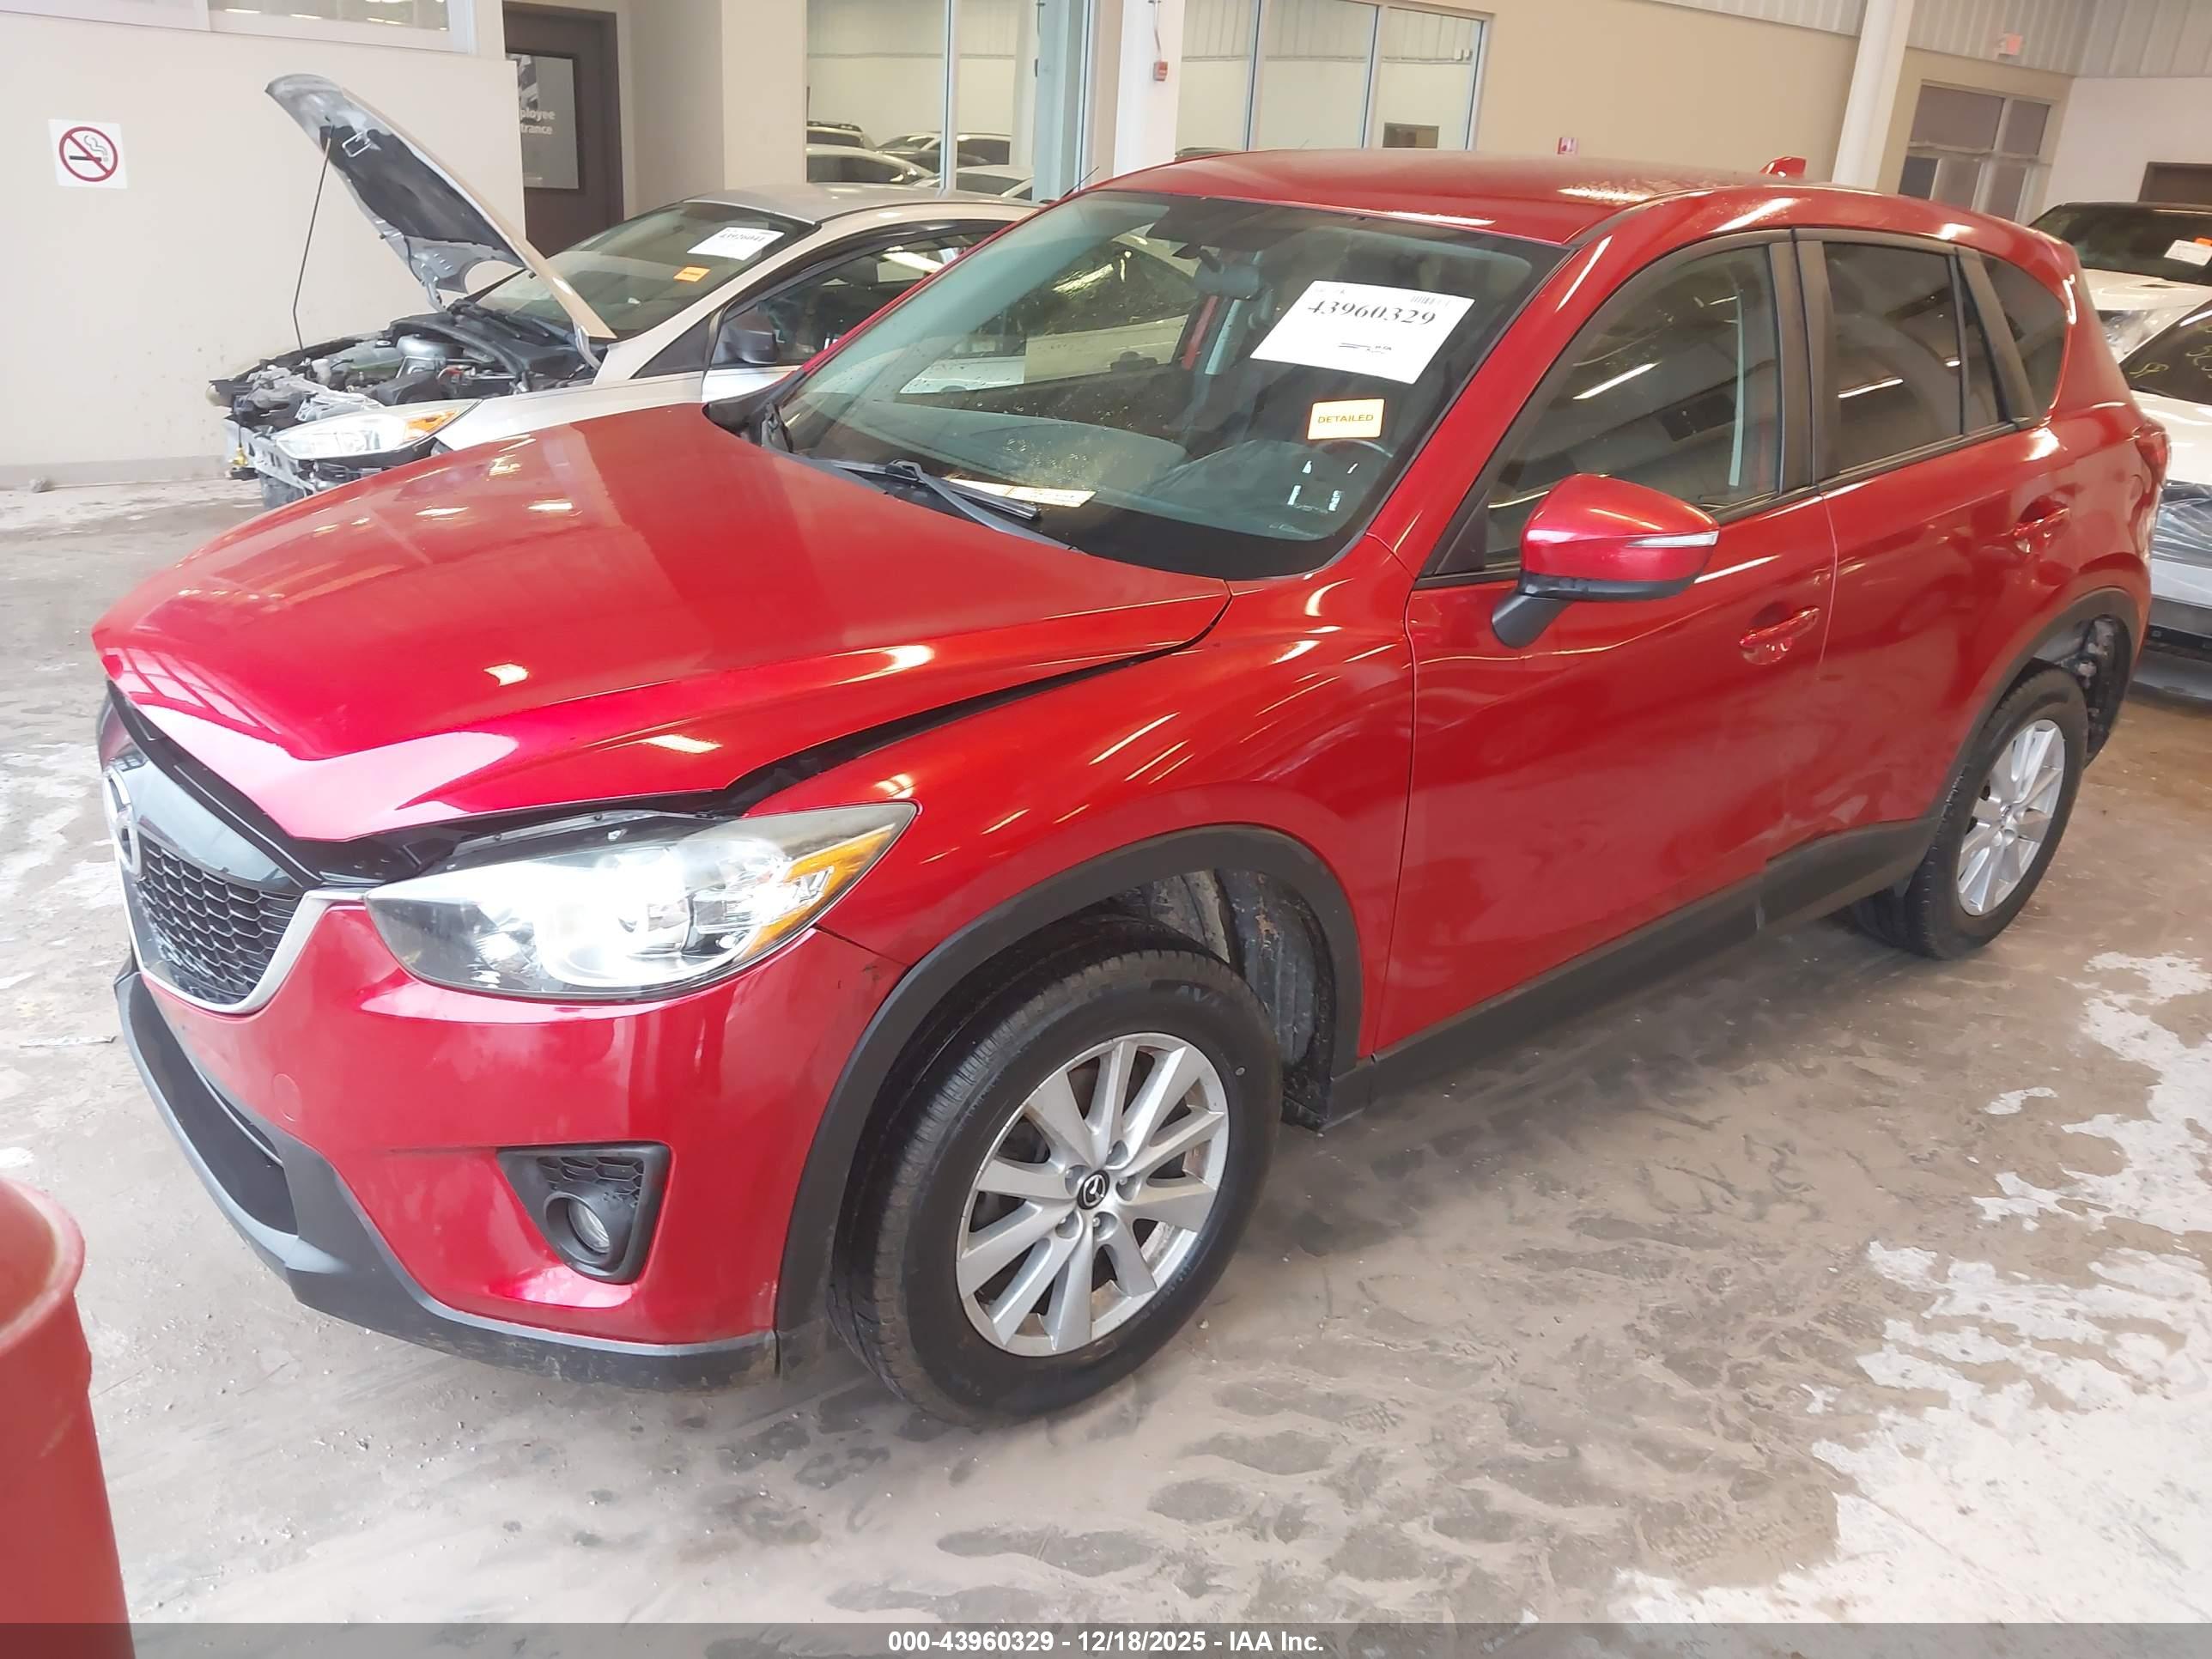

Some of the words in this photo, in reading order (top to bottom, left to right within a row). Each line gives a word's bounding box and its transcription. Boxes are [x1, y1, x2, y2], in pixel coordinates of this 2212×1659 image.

[520, 107, 556, 122] ployee
[520, 123, 553, 135] trance
[1308, 300, 1437, 325] 43960329
[1317, 414, 1374, 423] DETAILED
